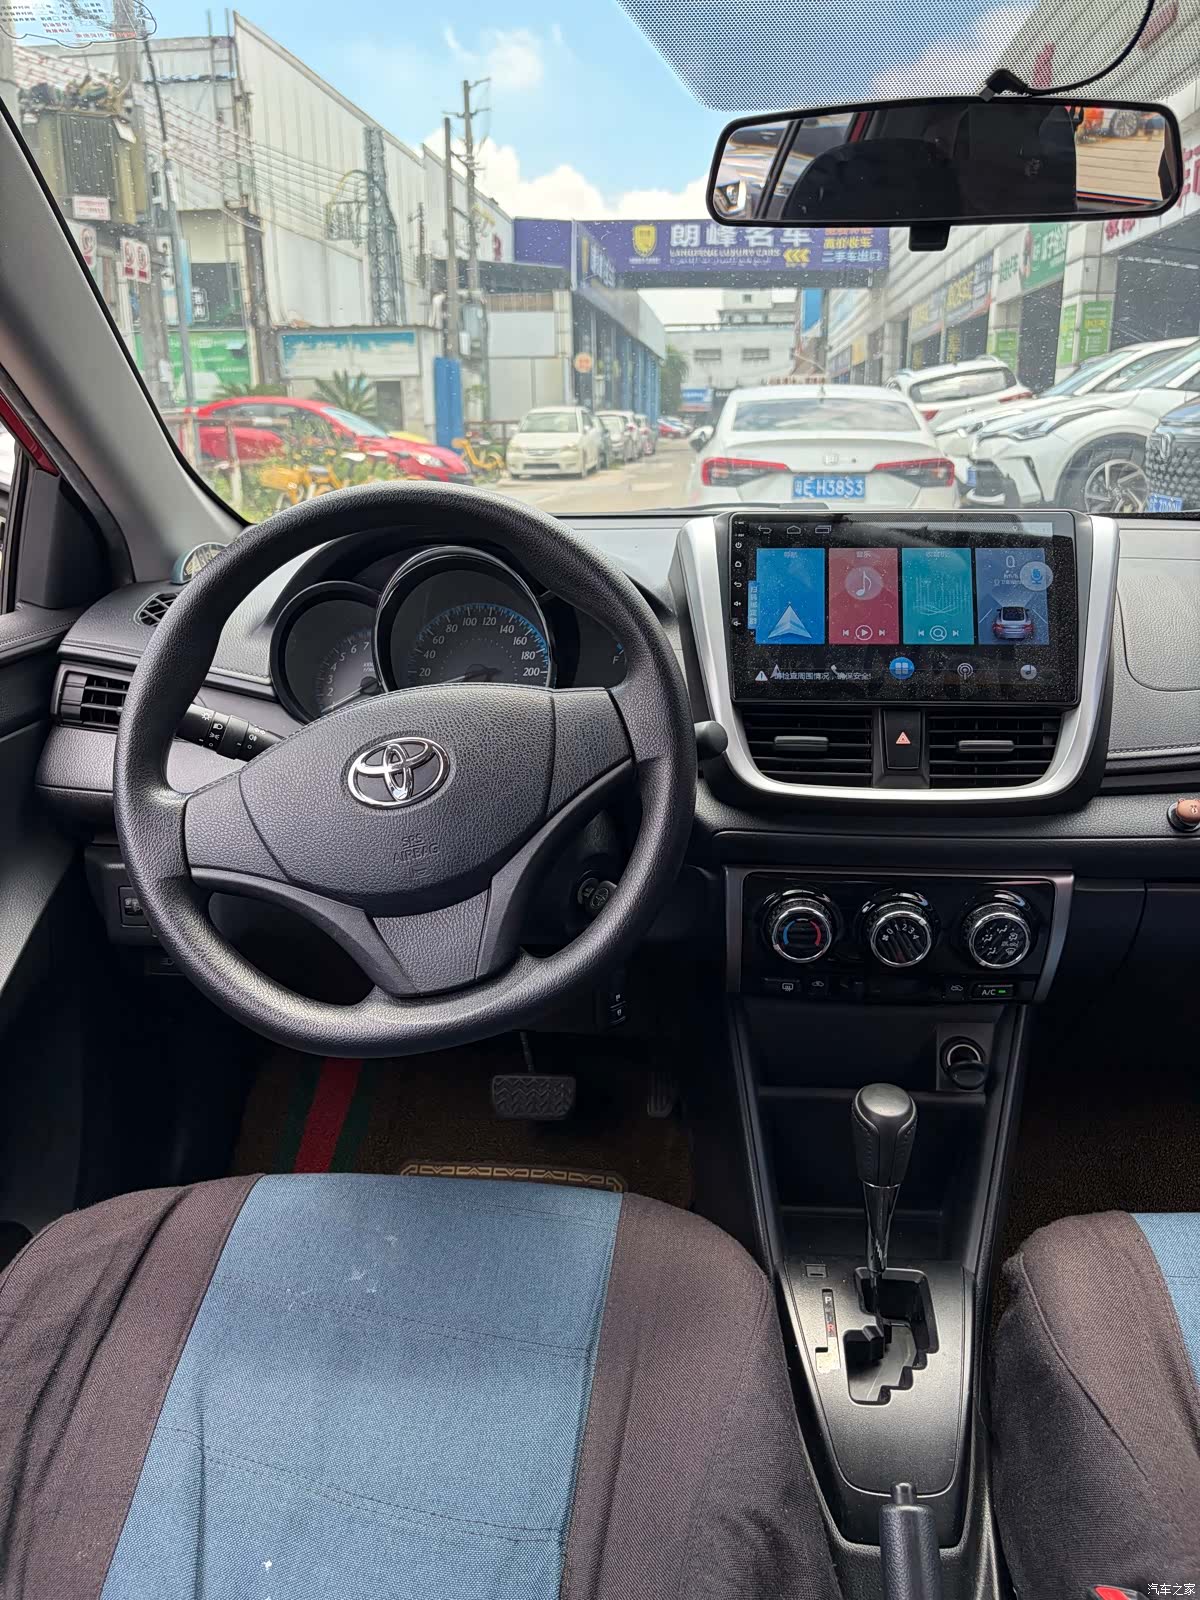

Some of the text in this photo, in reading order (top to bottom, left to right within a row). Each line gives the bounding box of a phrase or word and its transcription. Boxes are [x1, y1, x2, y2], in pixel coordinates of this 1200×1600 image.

[670, 223, 812, 247] 朗峰名车
[462, 617, 478, 627] 100
[482, 616, 497, 626] 120
[445, 623, 458, 633] 80
[500, 624, 515, 634] 140
[432, 635, 445, 645] 60
[513, 636, 528, 646] 160
[350, 644, 357, 654] 6
[363, 641, 370, 651] 7
[339, 652, 346, 662] 5
[423, 650, 436, 659] 40
[521, 651, 536, 660] 180
[612, 655, 620, 665] F
[330, 662, 338, 672] 4
[419, 667, 432, 677] 20
[523, 667, 541, 677] 200
[327, 674, 334, 685] 3
[326, 687, 334, 697] 2
[981, 988, 996, 996] A/C
[825, 1296, 832, 1304] P
[826, 1324, 834, 1333] R
